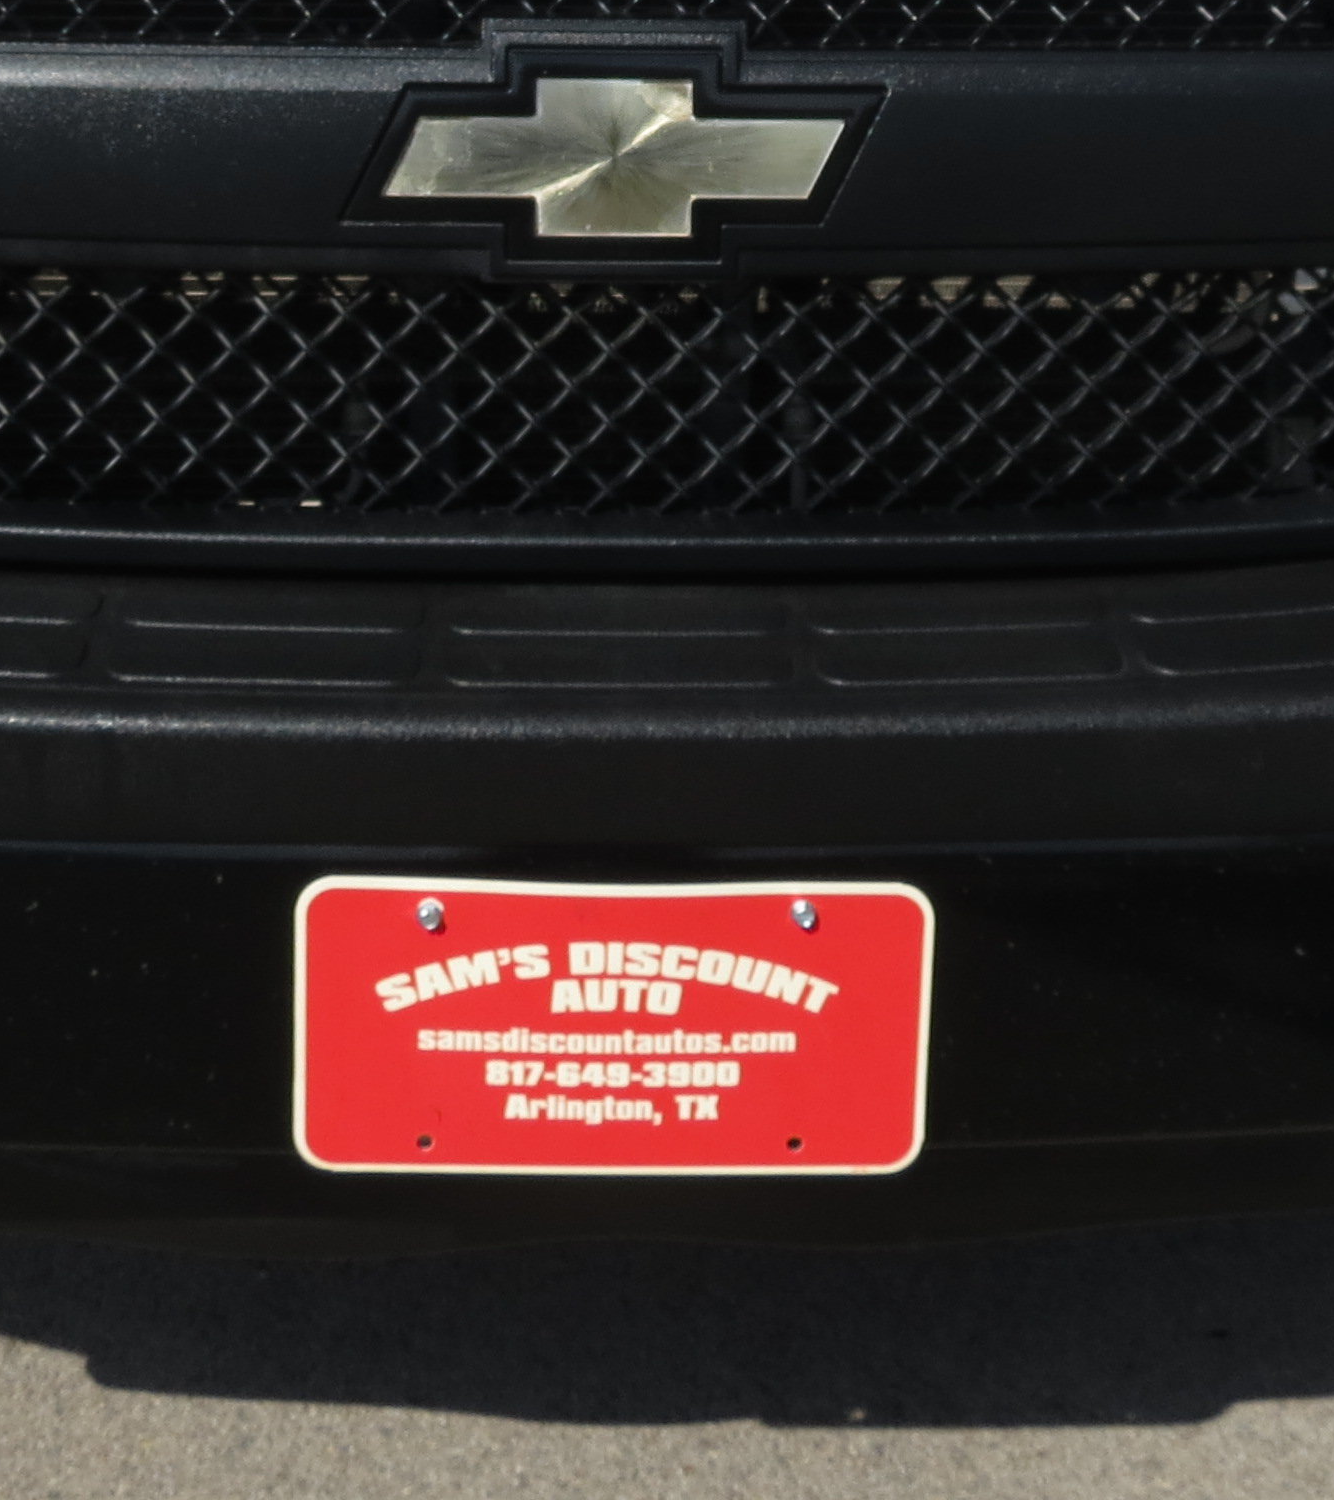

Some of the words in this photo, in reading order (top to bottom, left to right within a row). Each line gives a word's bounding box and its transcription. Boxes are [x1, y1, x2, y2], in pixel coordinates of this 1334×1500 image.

[375, 944, 550, 1013] SAM'S
[569, 942, 839, 1013] DISCOUNT
[551, 979, 682, 1015] AUTO
[417, 1028, 797, 1055] samsdiscountautos.com
[485, 1060, 740, 1088] 817-649-3900
[504, 1094, 663, 1125] Arlington,
[674, 1095, 719, 1121] TX
